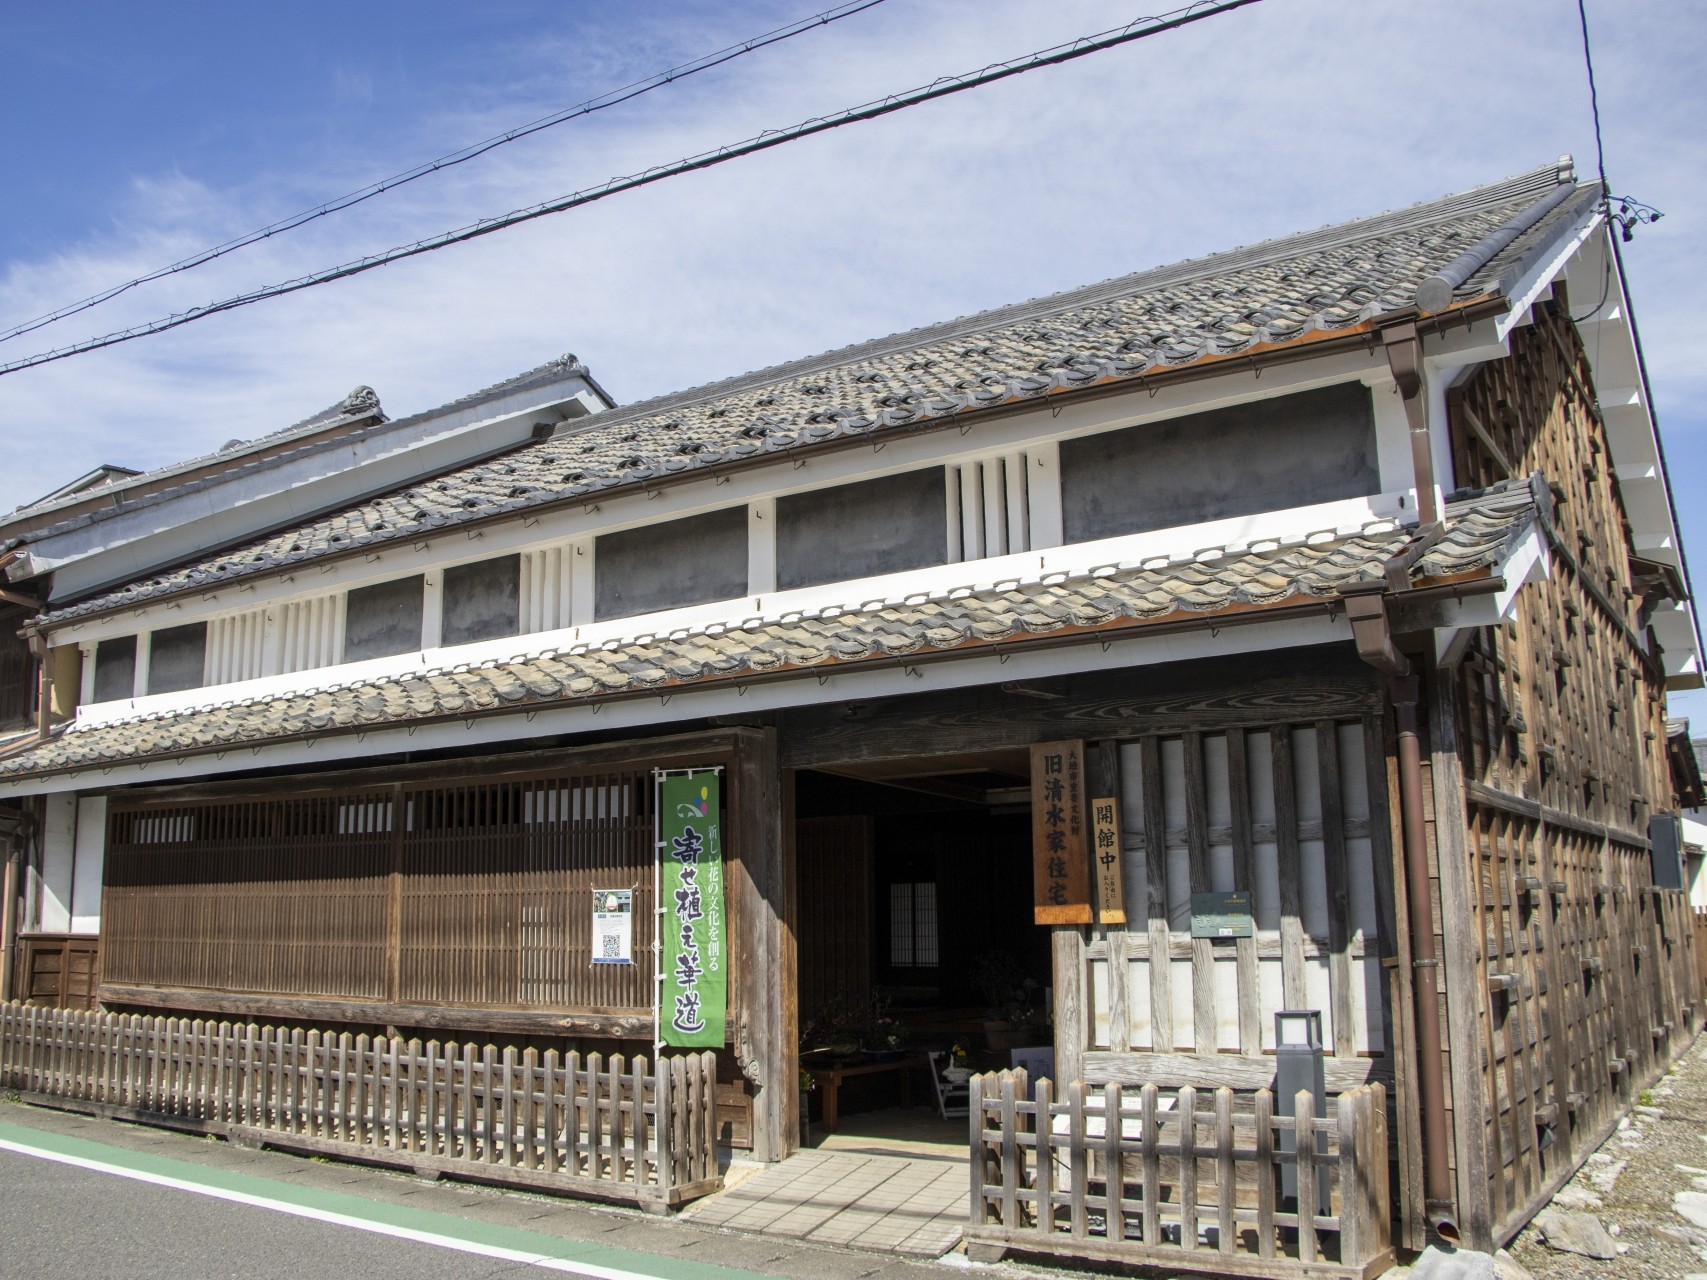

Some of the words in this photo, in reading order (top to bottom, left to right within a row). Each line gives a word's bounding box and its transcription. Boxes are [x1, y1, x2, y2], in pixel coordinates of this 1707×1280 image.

[1044, 754, 1068, 905] 旧清水家住宅
[1068, 751, 1080, 836] 大垣市重要文化財
[1096, 804, 1117, 872] 開館中
[673, 826, 705, 1033] 寄せ植え華道
[707, 824, 720, 971] 新しい花の文化を創る
